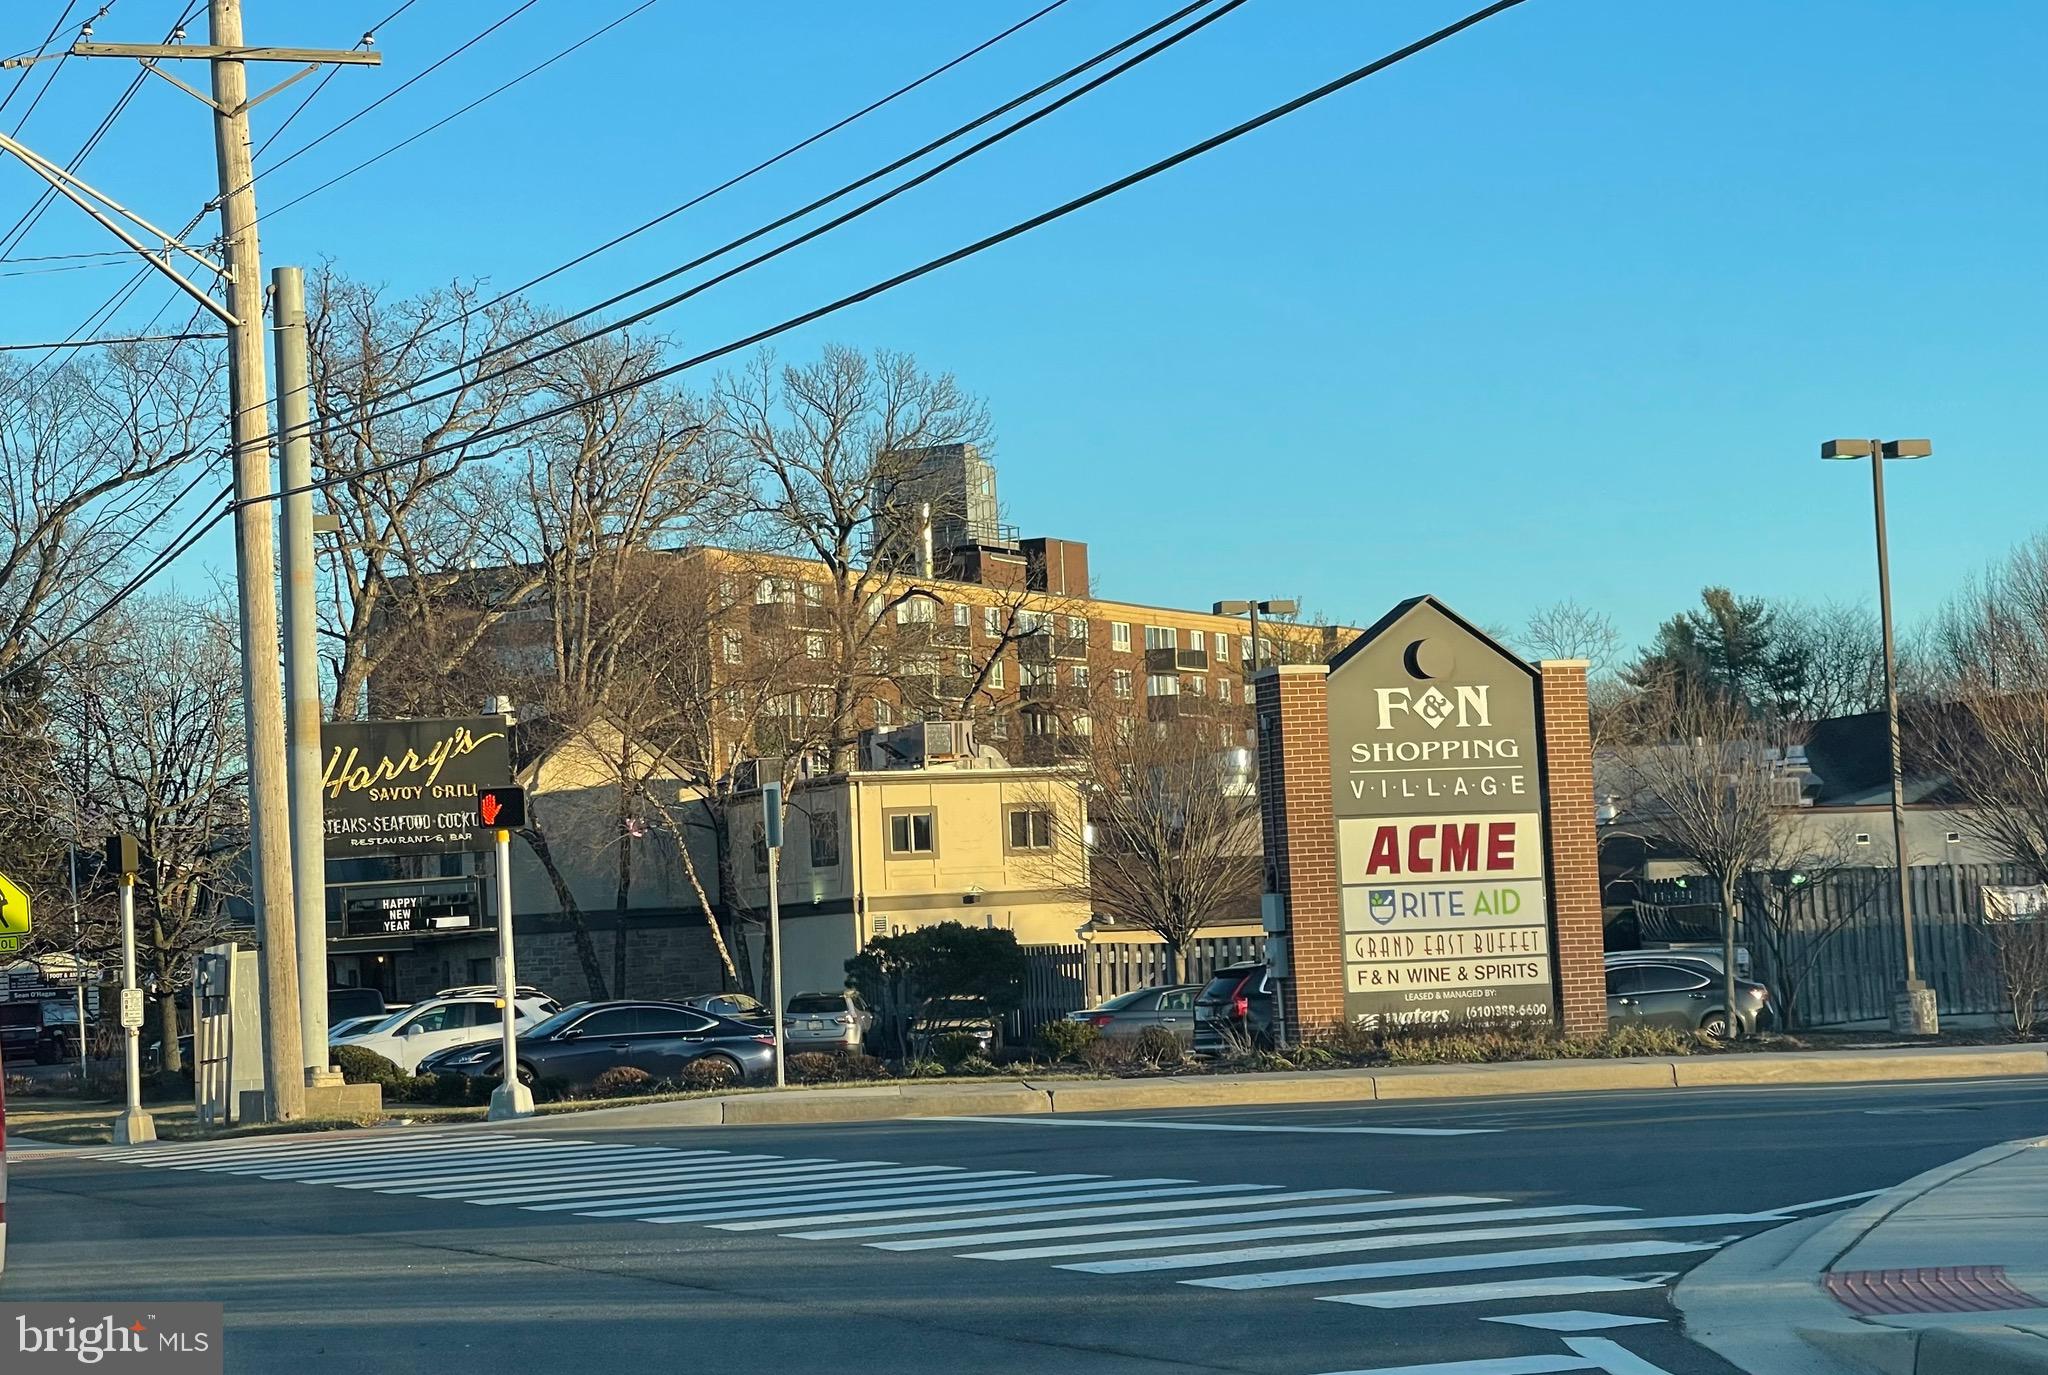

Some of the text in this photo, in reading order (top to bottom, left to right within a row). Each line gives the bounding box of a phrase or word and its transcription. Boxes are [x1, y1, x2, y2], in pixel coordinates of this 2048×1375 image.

[1373, 685, 1492, 730] F&N
[1351, 738, 1520, 763] SHOPPING
[322, 726, 505, 799] Harry's
[368, 786, 423, 802] SAVOY
[350, 834, 431, 846] RESTAURANT
[449, 832, 473, 841] BAR
[1365, 822, 1517, 876] ACME
[382, 897, 417, 910] HAPPY
[1401, 888, 1521, 918] RITE AID
[389, 908, 411, 920] NEW
[383, 920, 410, 932] YEAR
[1355, 930, 1538, 959] GRAND EAST BUFFET
[1407, 967, 1451, 983] WINE
[1457, 966, 1468, 981] &
[1474, 962, 1539, 980] SPIRITS
[1405, 992, 1434, 1002] LEASED
[1442, 989, 1484, 1000] MANAGED
